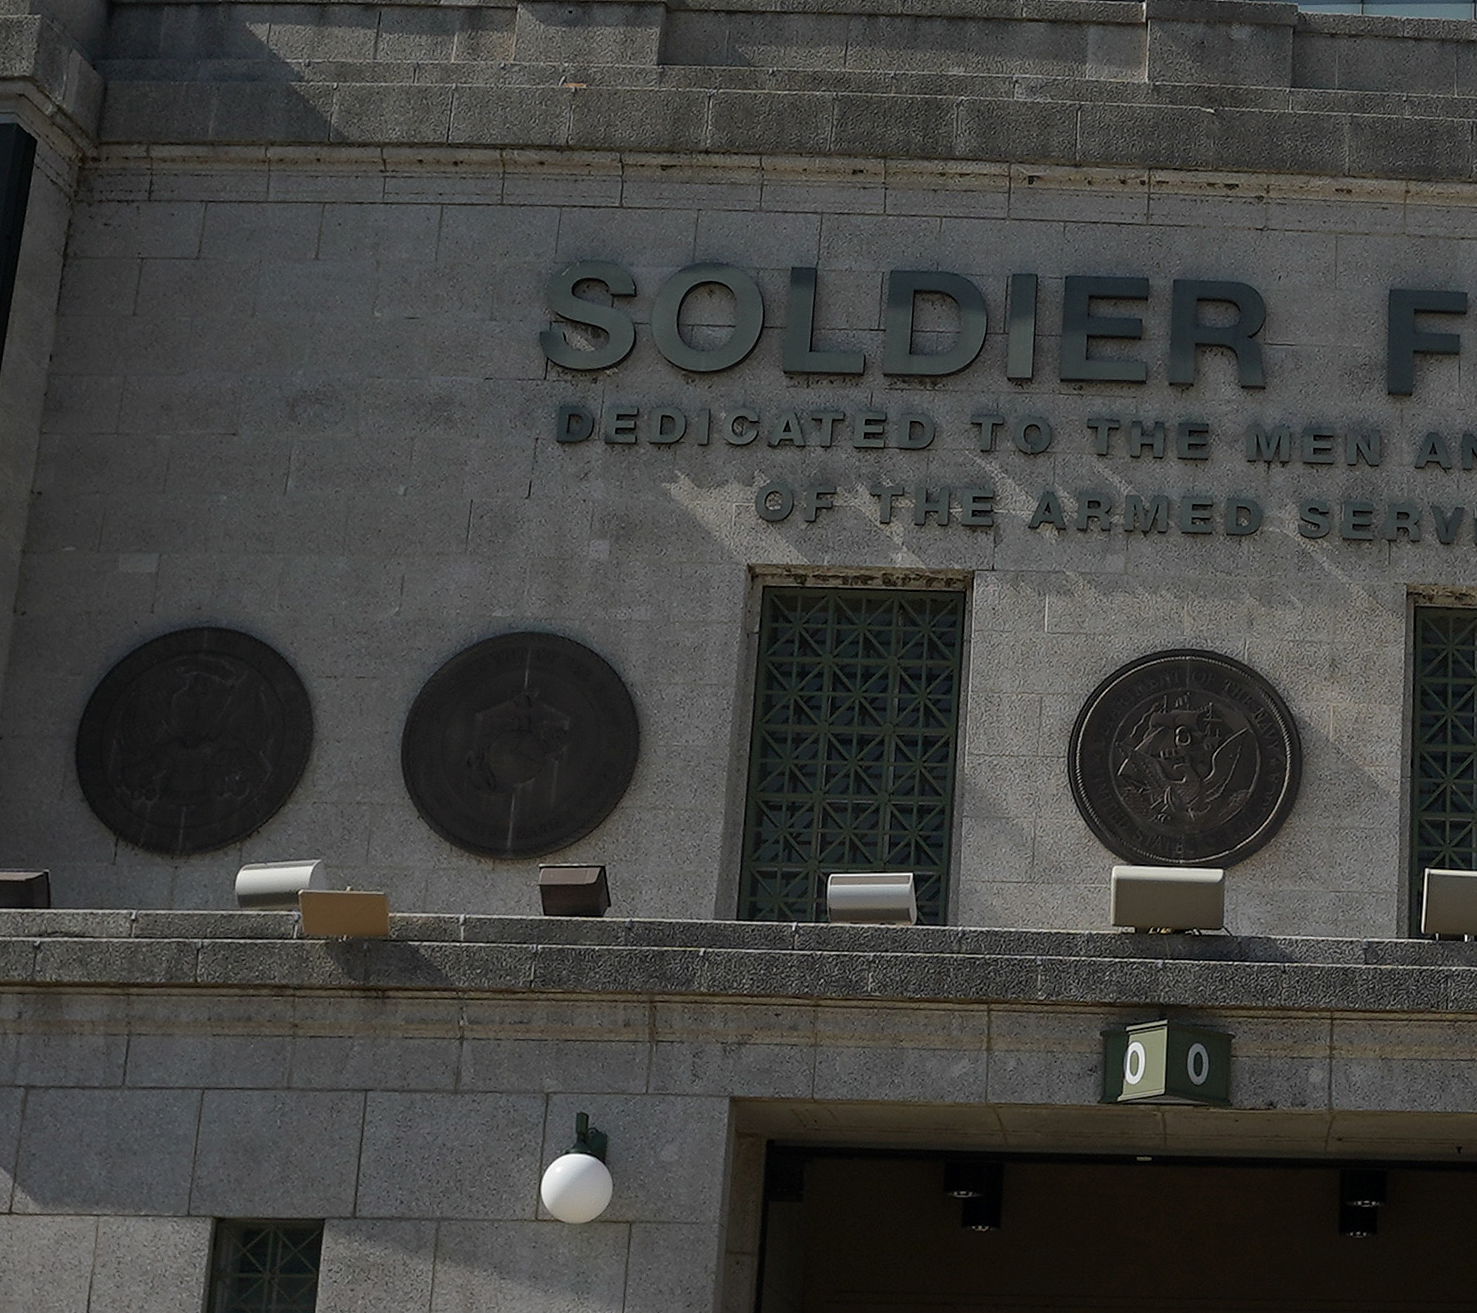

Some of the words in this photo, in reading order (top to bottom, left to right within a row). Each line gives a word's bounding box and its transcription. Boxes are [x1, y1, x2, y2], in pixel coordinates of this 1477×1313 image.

[540, 259, 1266, 389] SOLDIER
[556, 405, 936, 450] DEDICATED
[970, 415, 1053, 455] TO
[1087, 418, 1209, 460] THE
[1245, 424, 1381, 466] MEN
[755, 485, 837, 523] OF
[870, 487, 994, 527] THE
[1028, 491, 1262, 536] ARMED
[1124, 1041, 1146, 1085] 0
[1187, 1043, 1209, 1086] 0
